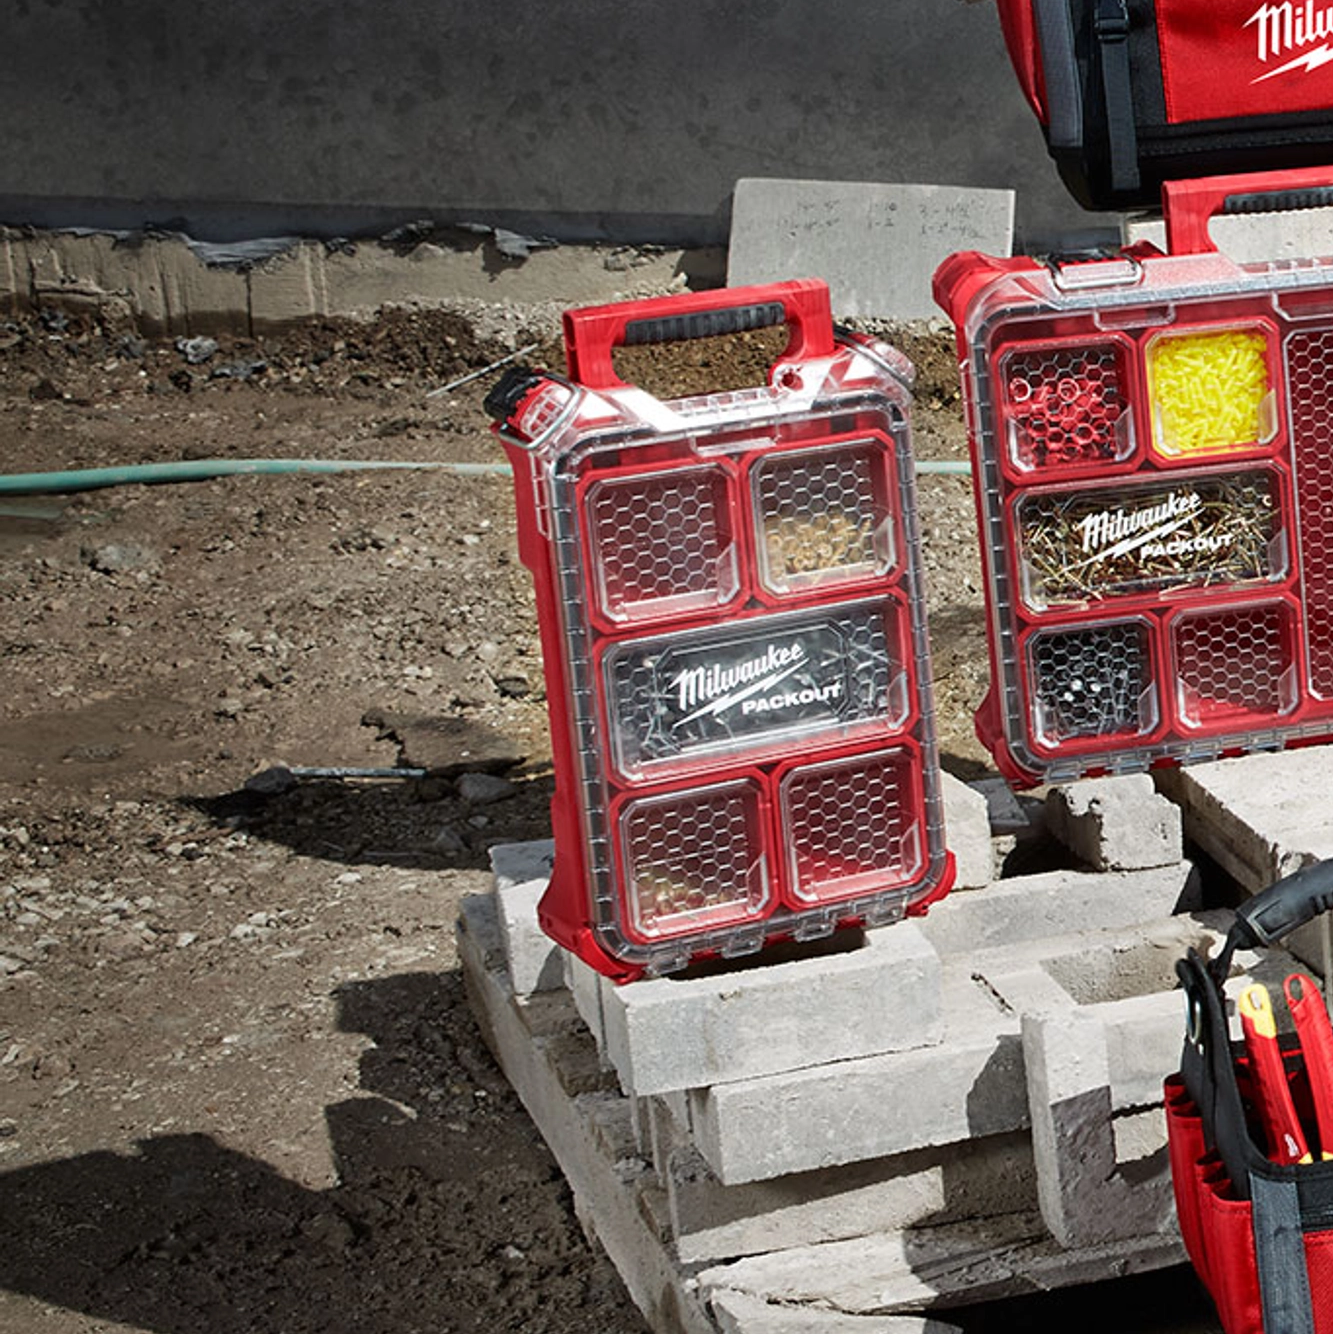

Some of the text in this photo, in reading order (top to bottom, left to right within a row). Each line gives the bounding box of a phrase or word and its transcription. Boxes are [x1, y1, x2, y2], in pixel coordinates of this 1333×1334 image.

[1072, 492, 1202, 553] Milwaukee
[1140, 533, 1234, 560] PACKOUT
[668, 643, 804, 712] Milwaukee
[741, 682, 842, 715] PACKOUT
